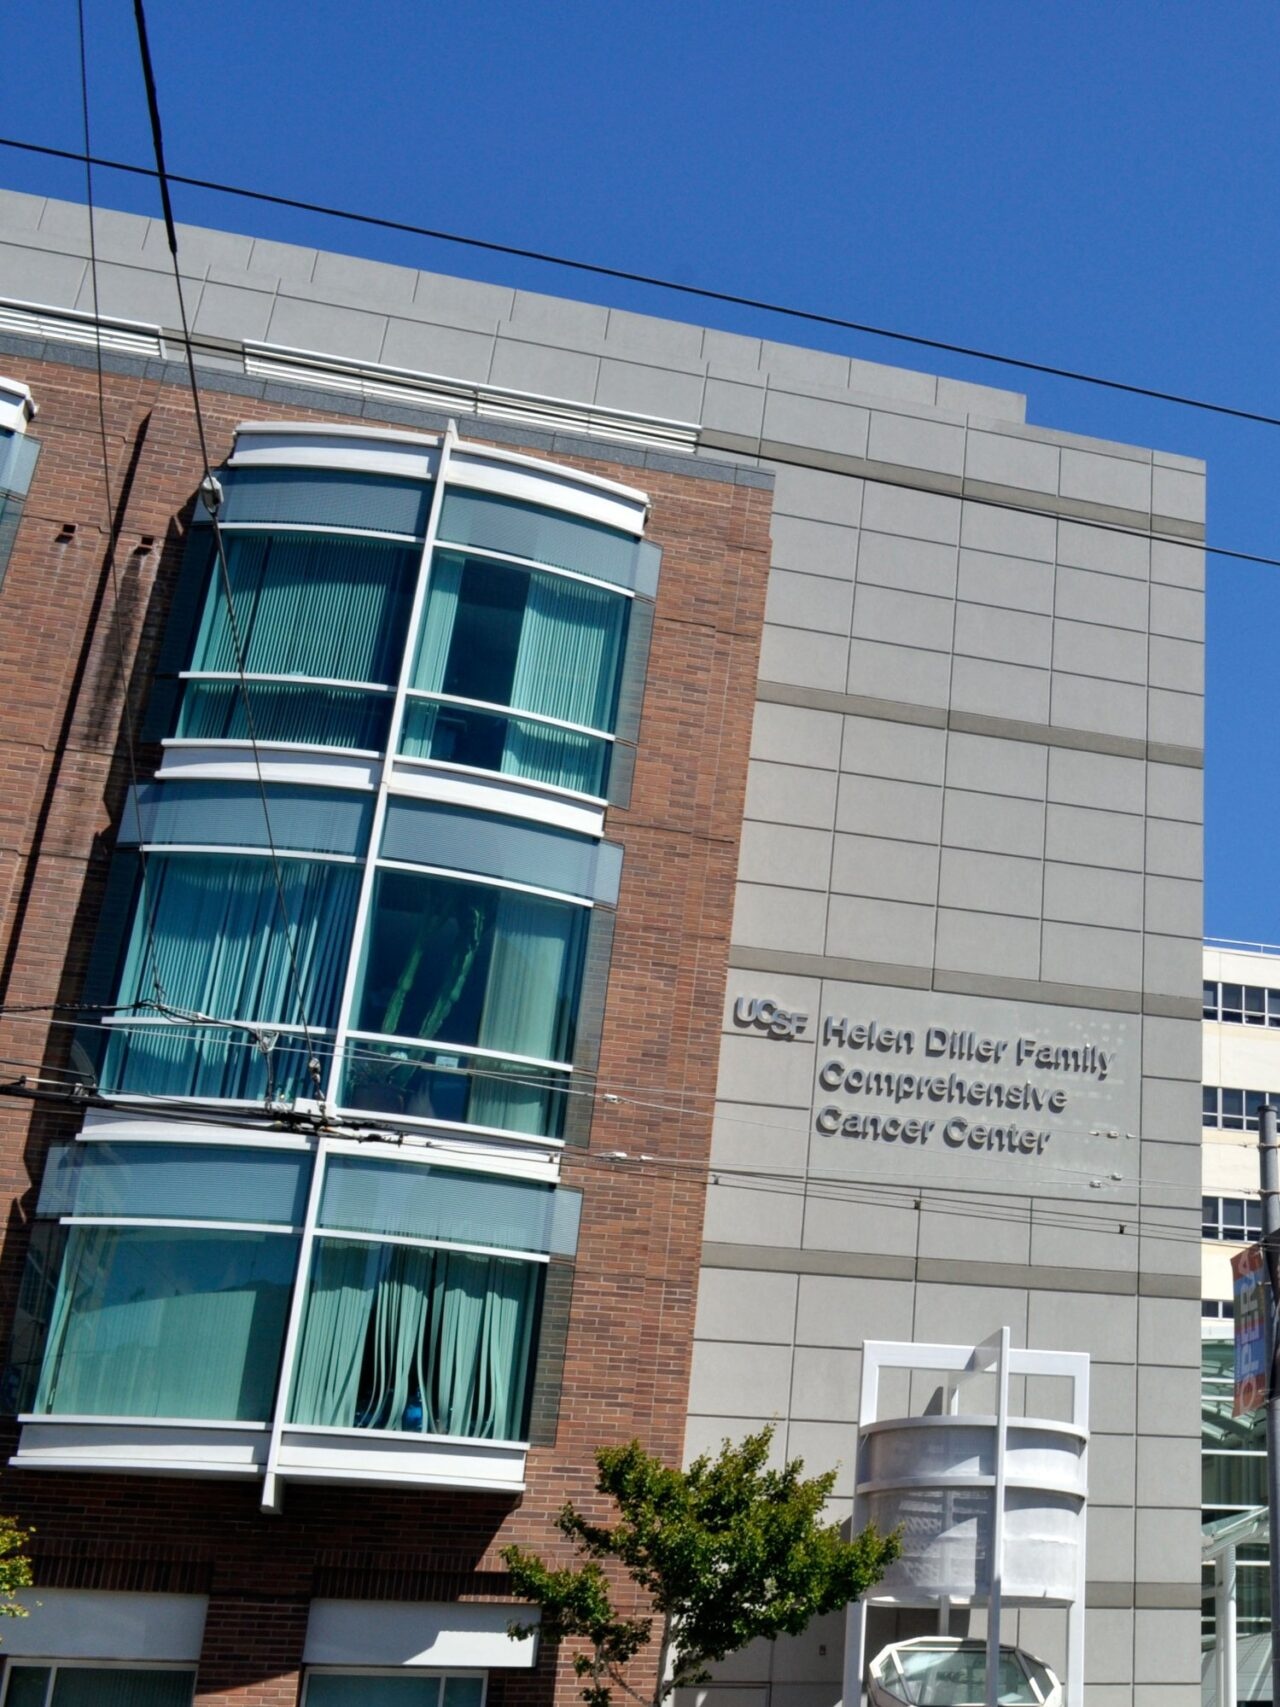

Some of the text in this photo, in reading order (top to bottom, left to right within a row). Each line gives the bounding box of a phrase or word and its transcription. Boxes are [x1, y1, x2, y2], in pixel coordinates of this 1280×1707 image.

[733, 995, 809, 1041] UCSF
[822, 1014, 1117, 1080] Helen Diller Family
[819, 1060, 1069, 1113] Comprehensive
[815, 1104, 1051, 1155] Cancer Center
